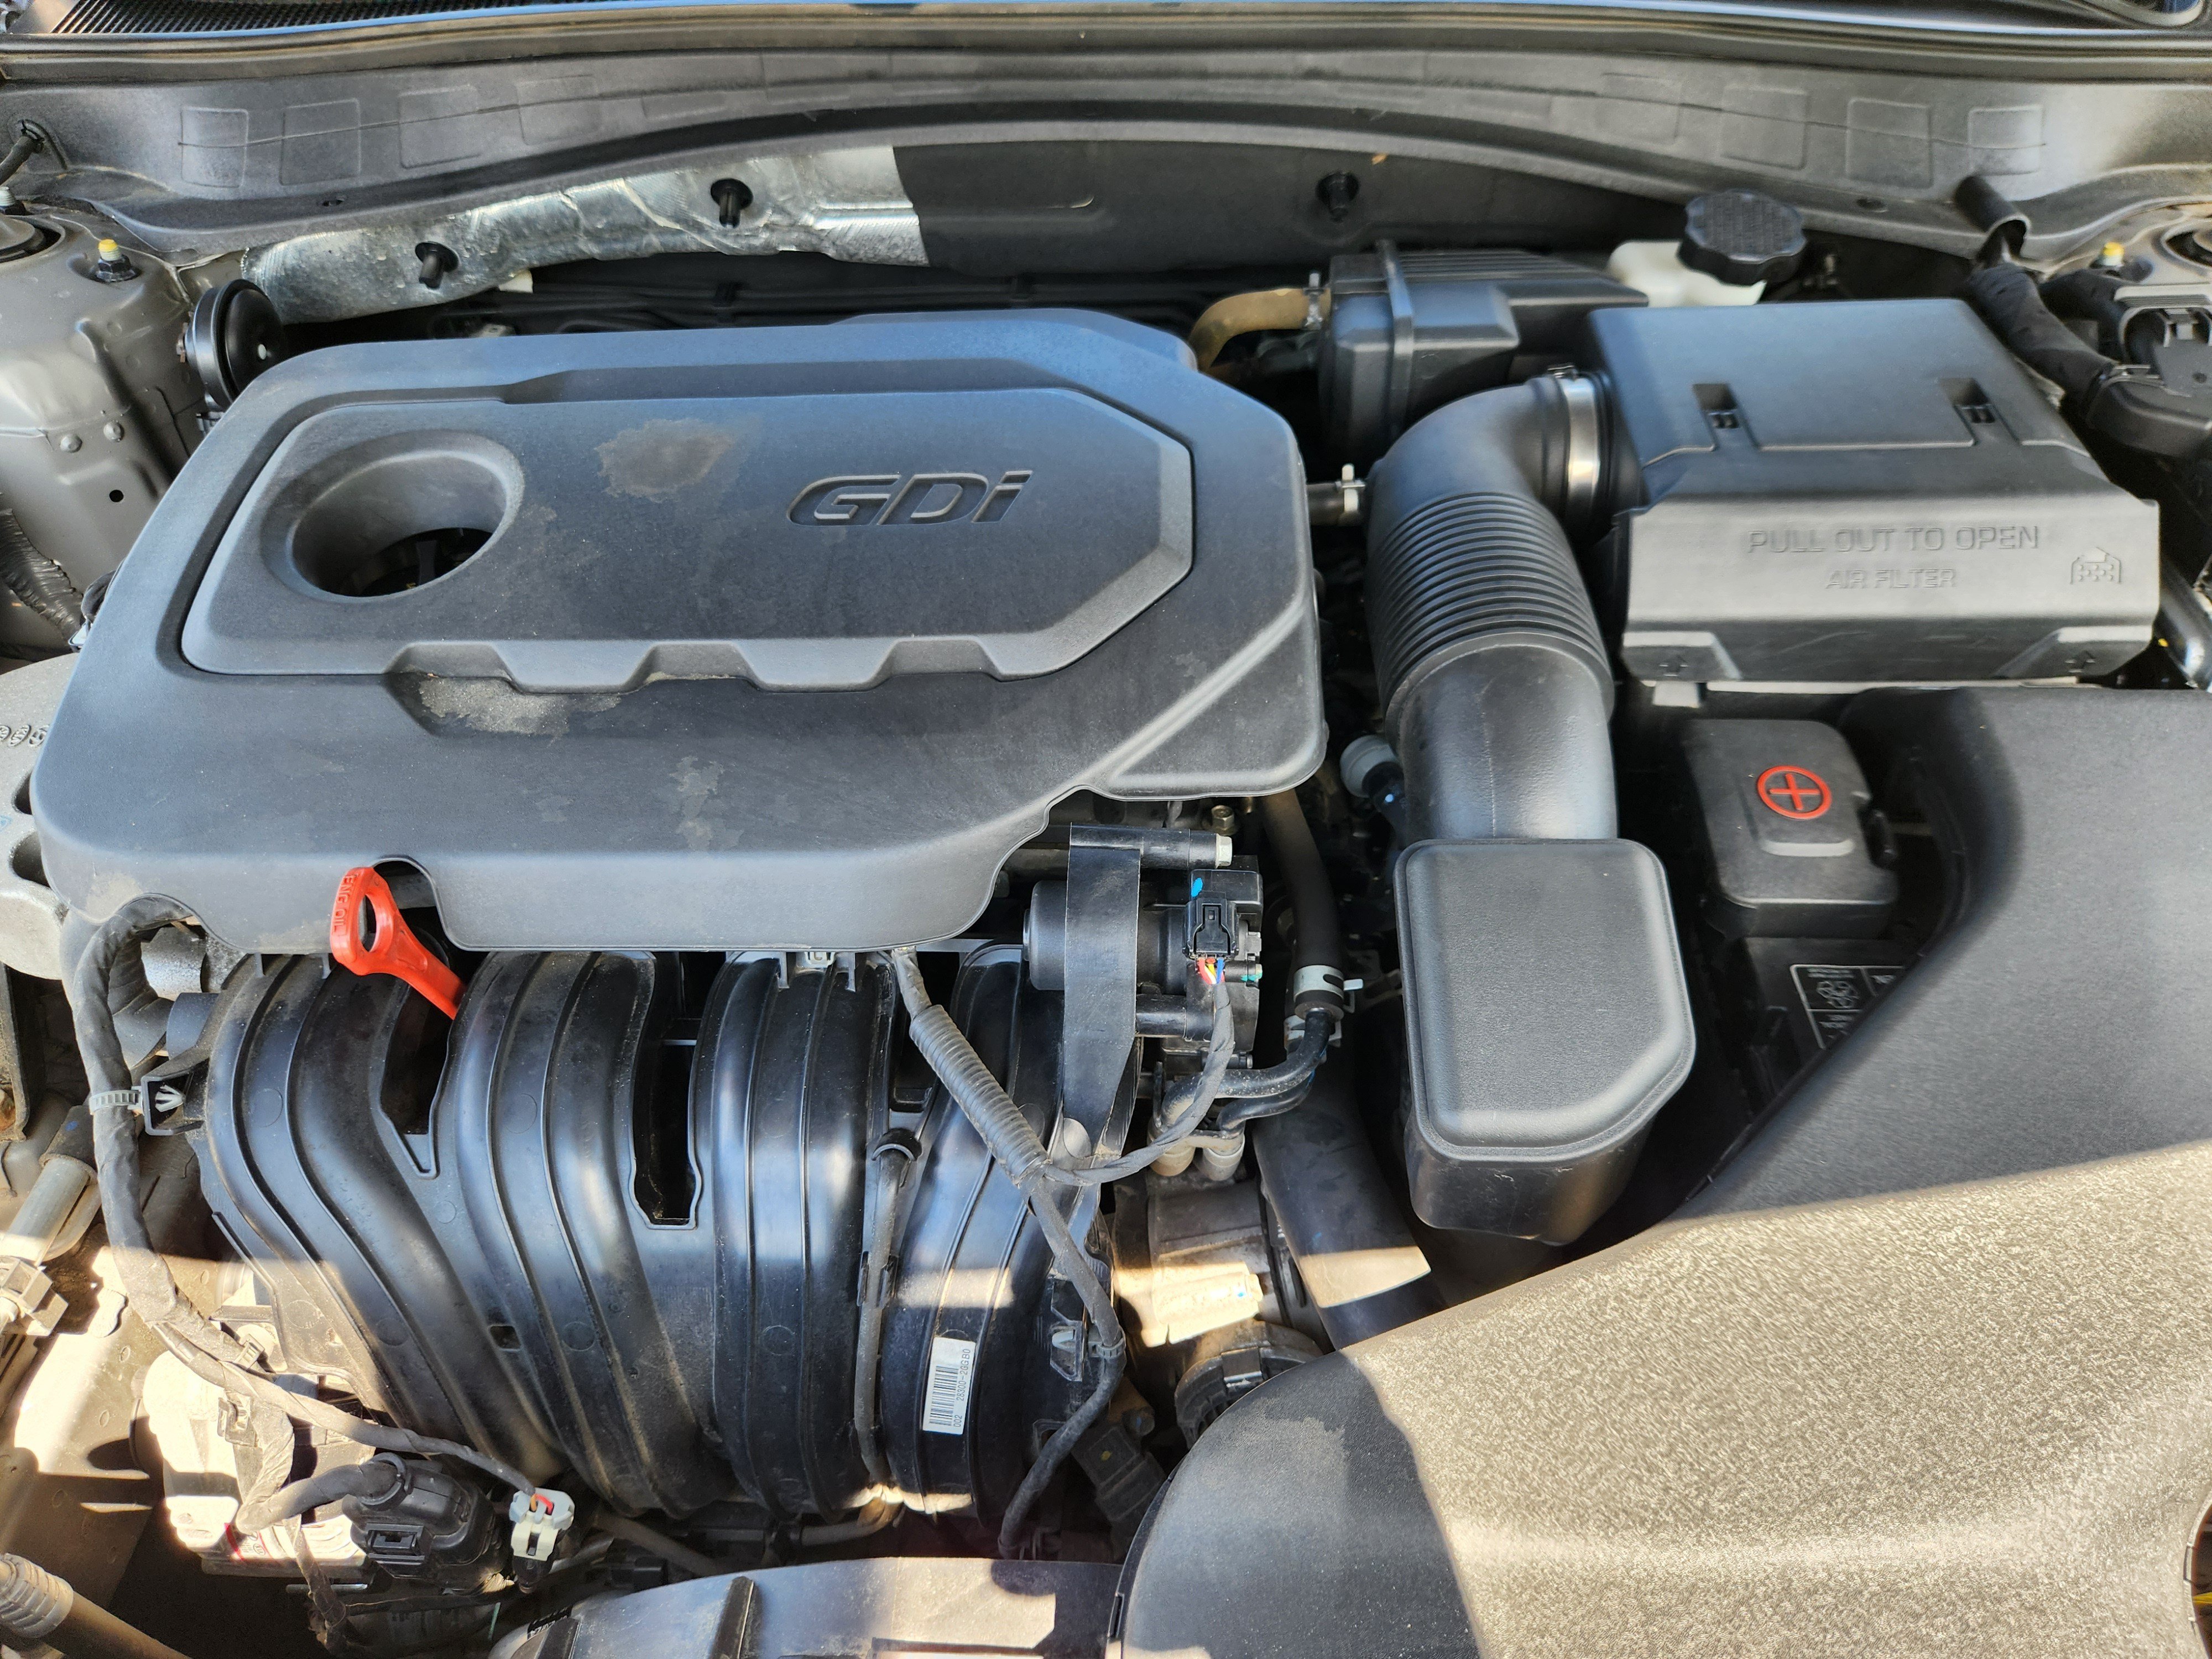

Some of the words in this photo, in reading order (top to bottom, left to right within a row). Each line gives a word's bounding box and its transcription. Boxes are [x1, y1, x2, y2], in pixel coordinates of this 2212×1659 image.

[786, 469, 1033, 526] GDi
[1747, 530, 1825, 554] PULL
[1834, 528, 1897, 552] OUT
[1905, 528, 1944, 551] TO
[1955, 525, 2039, 550] OPEN
[1825, 569, 1868, 589] AIR
[1873, 568, 1958, 589] FILTER
[337, 874, 356, 904] ENG
[333, 909, 347, 933] OIL
[953, 1414, 963, 1428] 002
